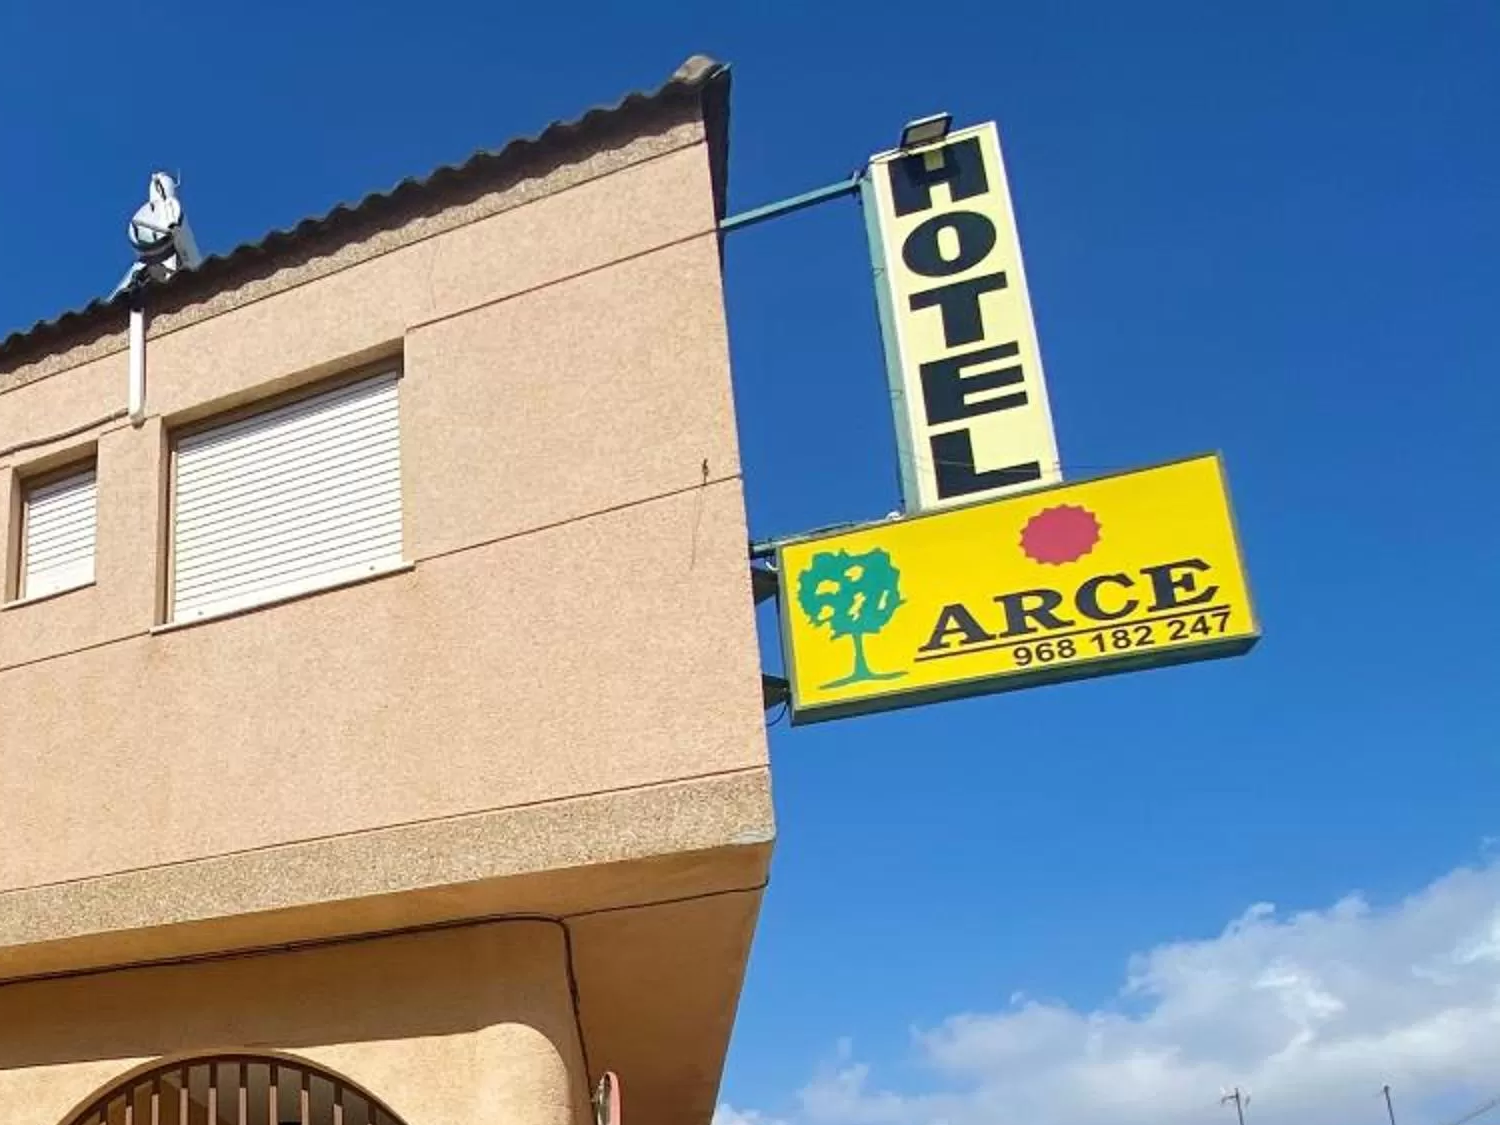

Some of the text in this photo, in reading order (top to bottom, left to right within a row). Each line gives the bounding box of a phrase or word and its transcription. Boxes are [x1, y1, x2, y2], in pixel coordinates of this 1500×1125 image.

[888, 136, 1041, 499] HOTEL
[918, 558, 1220, 652] ARCE
[1013, 611, 1232, 667] 968 182 247
